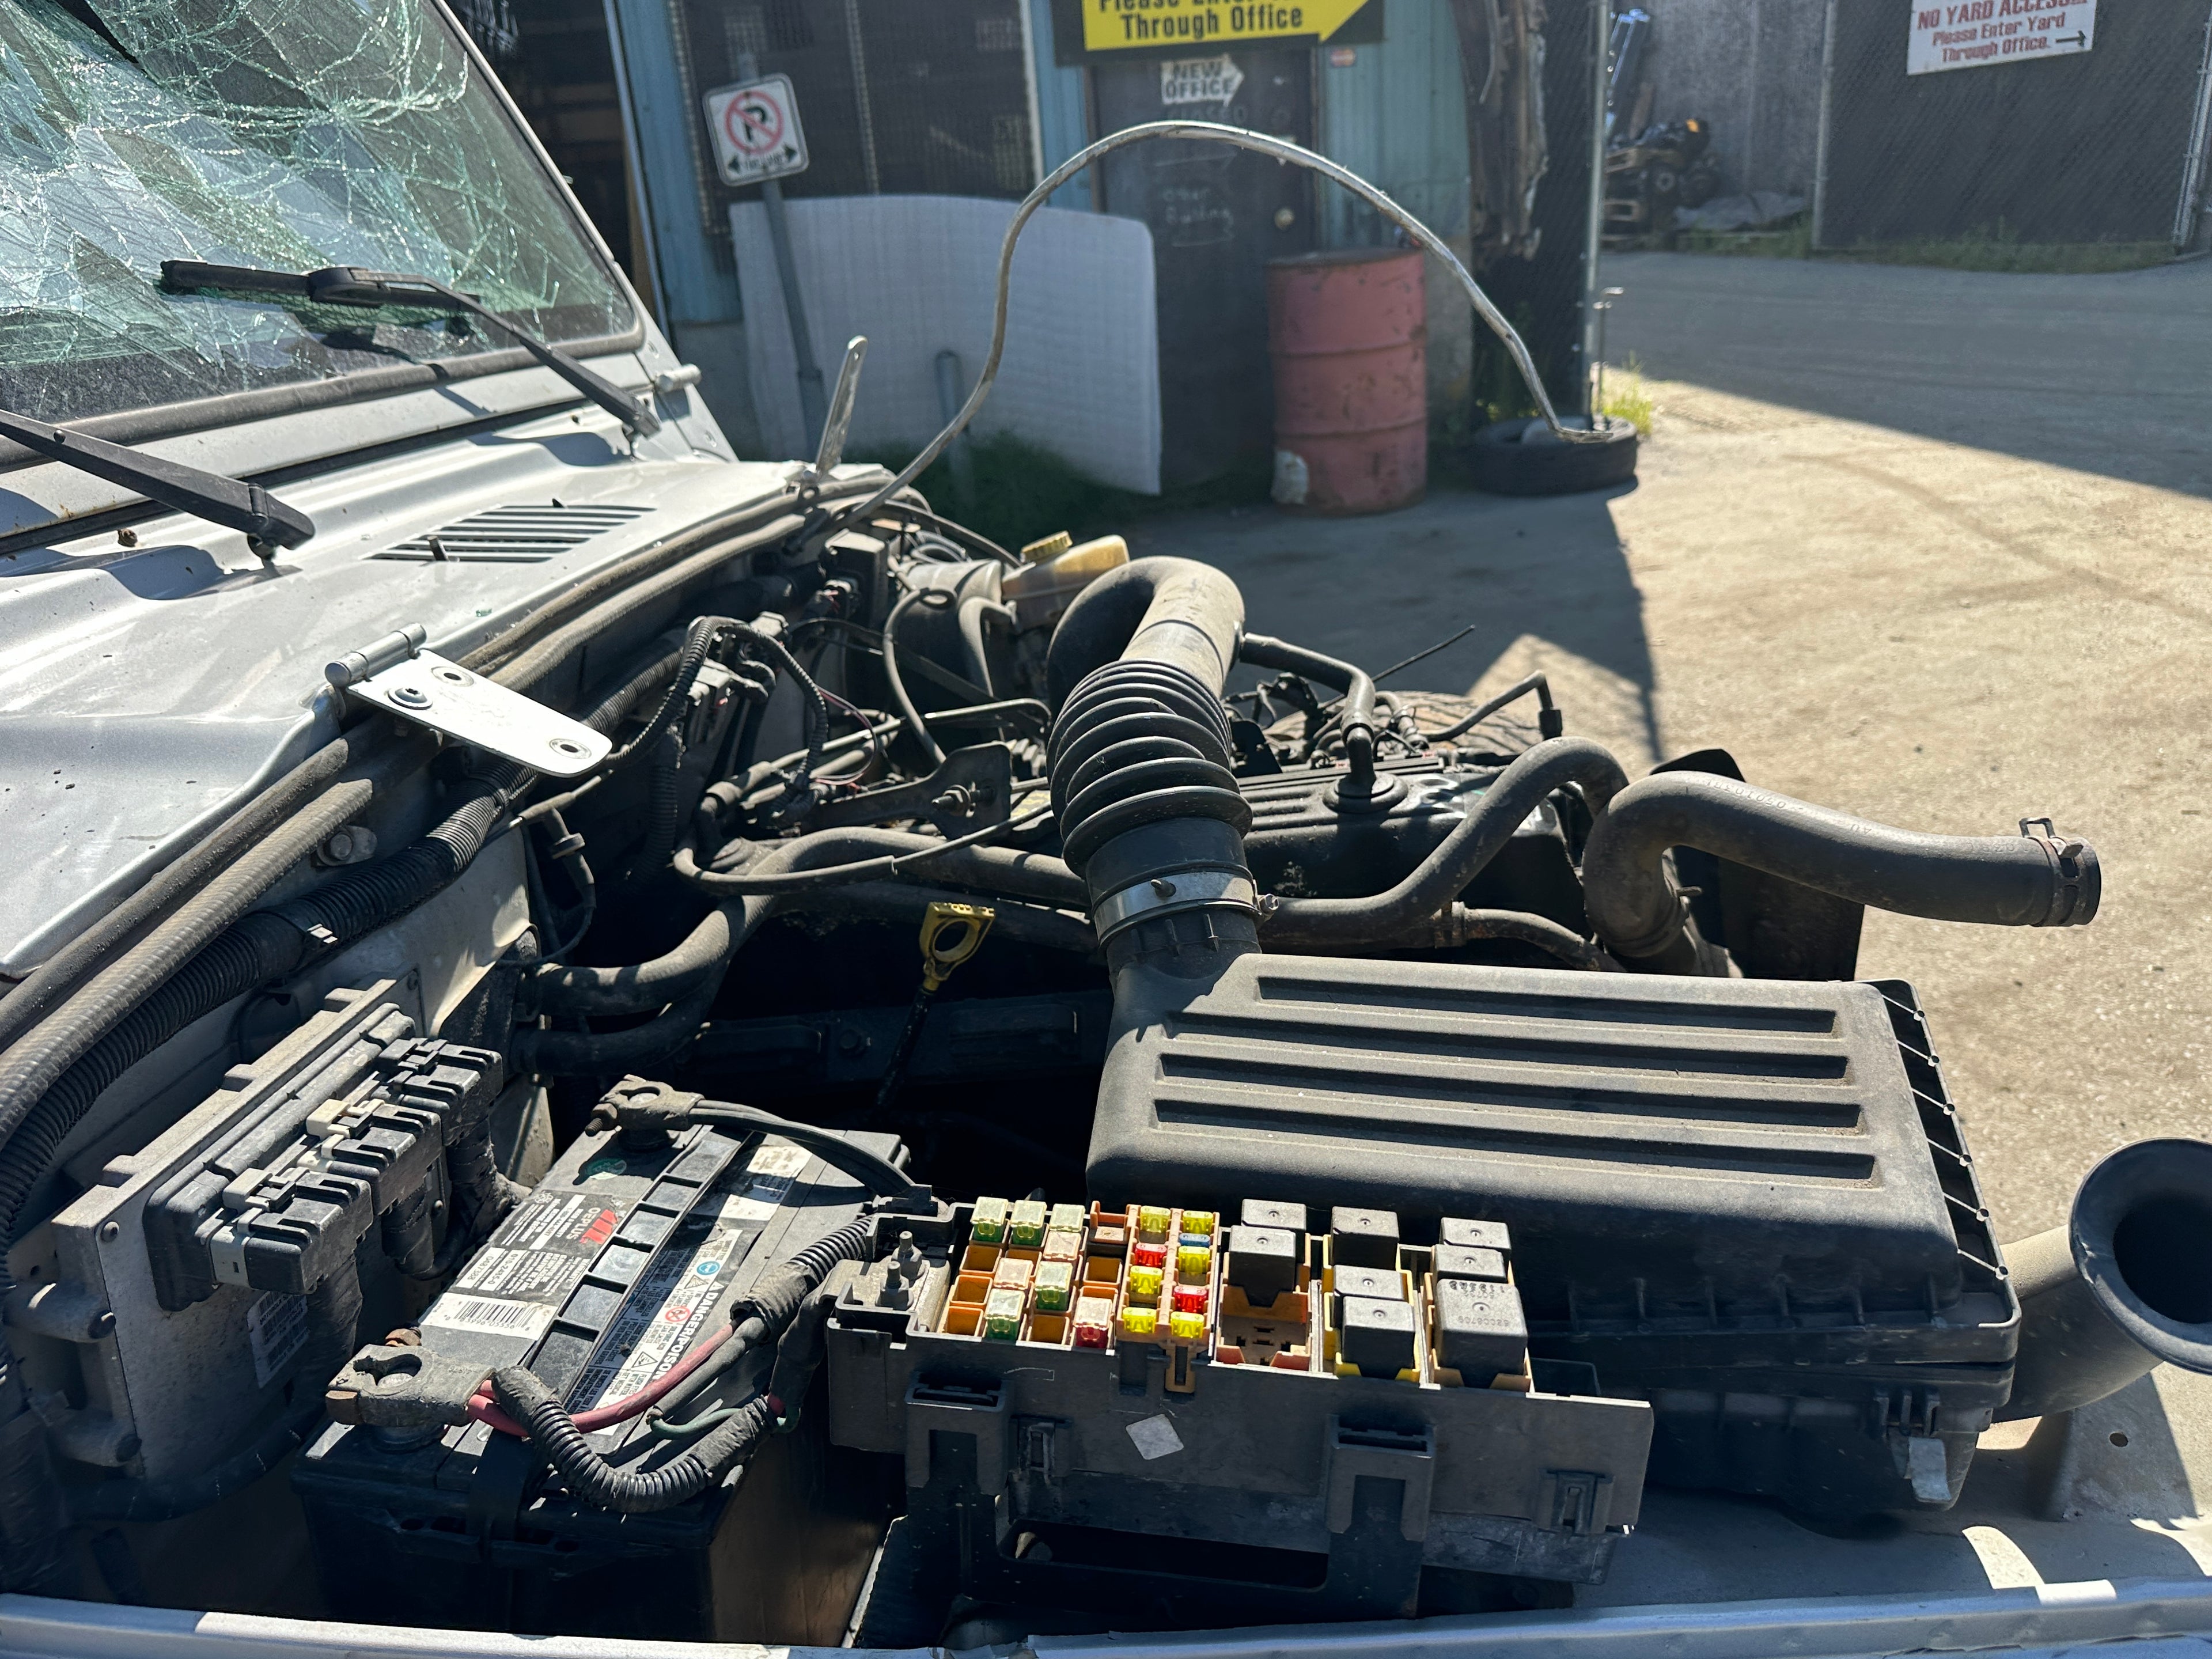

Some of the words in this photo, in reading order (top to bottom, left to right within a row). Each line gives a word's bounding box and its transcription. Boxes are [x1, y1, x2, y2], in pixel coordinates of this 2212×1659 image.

[1121, 10, 1219, 40] Through
[1230, 6, 1302, 32] Office
[1918, 9, 1940, 29] NO
[1947, 2, 1994, 25] YARD
[1933, 29, 1977, 46] Please
[1981, 21, 2023, 39] Enter
[2027, 12, 2065, 31] Yard
[1942, 43, 1998, 62] Through
[1173, 60, 1224, 80] NEW
[1165, 77, 1234, 100] OFFICE
[569, 1207, 600, 1239] OEPLUS
[653, 1290, 719, 1379] DANGER/POISON
